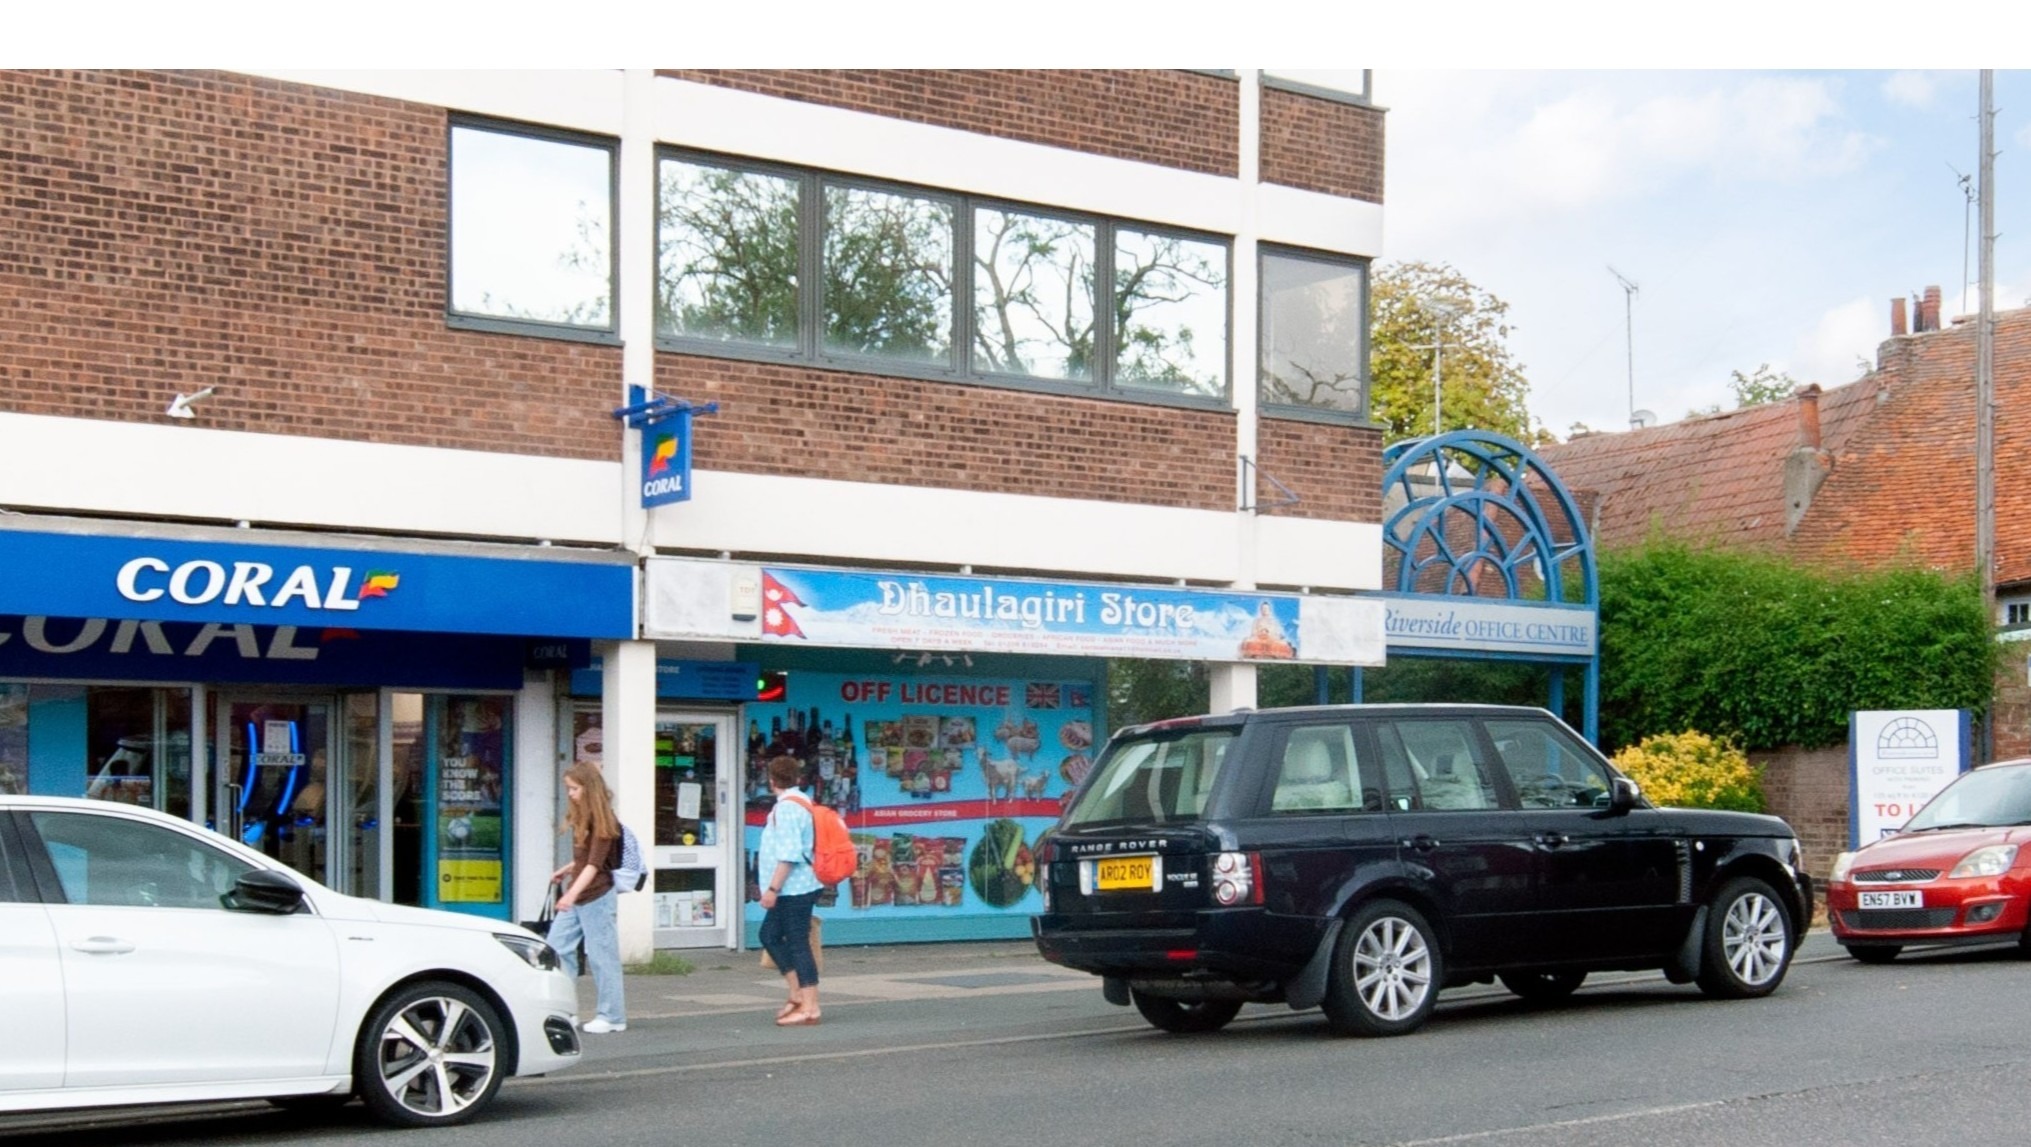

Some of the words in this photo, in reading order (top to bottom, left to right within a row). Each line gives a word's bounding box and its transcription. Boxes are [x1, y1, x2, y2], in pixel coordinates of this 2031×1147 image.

[644, 475, 682, 497] CORAL
[116, 557, 361, 611] CORAL
[877, 580, 1085, 628] Dhaulagiri
[1100, 592, 1195, 629] Store
[1385, 608, 1462, 636] Riverside
[1465, 619, 1522, 639] OFFICE
[1526, 622, 1589, 643] CENTRE
[0, 615, 319, 661] ORAL
[929, 629, 960, 637] FROZEN
[962, 630, 982, 638] FOOD
[1042, 634, 1073, 642] AFRICAN
[1076, 635, 1096, 643] FOOD
[1126, 637, 1146, 645] FOOD
[1154, 638, 1175, 646] MUCH
[1178, 639, 1198, 647] MORE
[533, 644, 568, 659] CORAL
[841, 681, 891, 702] OFF
[901, 683, 1010, 706] LICENCE
[442, 757, 467, 767] YOU
[442, 768, 479, 779] KNOW
[1872, 766, 1908, 775] OFFICE
[1911, 766, 1945, 775] SUITES
[442, 779, 466, 790] THE
[442, 790, 482, 801] SCORE
[873, 809, 897, 818] ASIAN
[898, 809, 932, 818] GROCERY
[934, 809, 958, 818] STORE
[1874, 803, 1901, 817] TO
[1071, 843, 1113, 853] RANGE
[1119, 839, 1168, 850] ROVER
[1101, 865, 1127, 881] AR02
[1129, 864, 1152, 880] ROY
[1863, 893, 1890, 906] EN57
